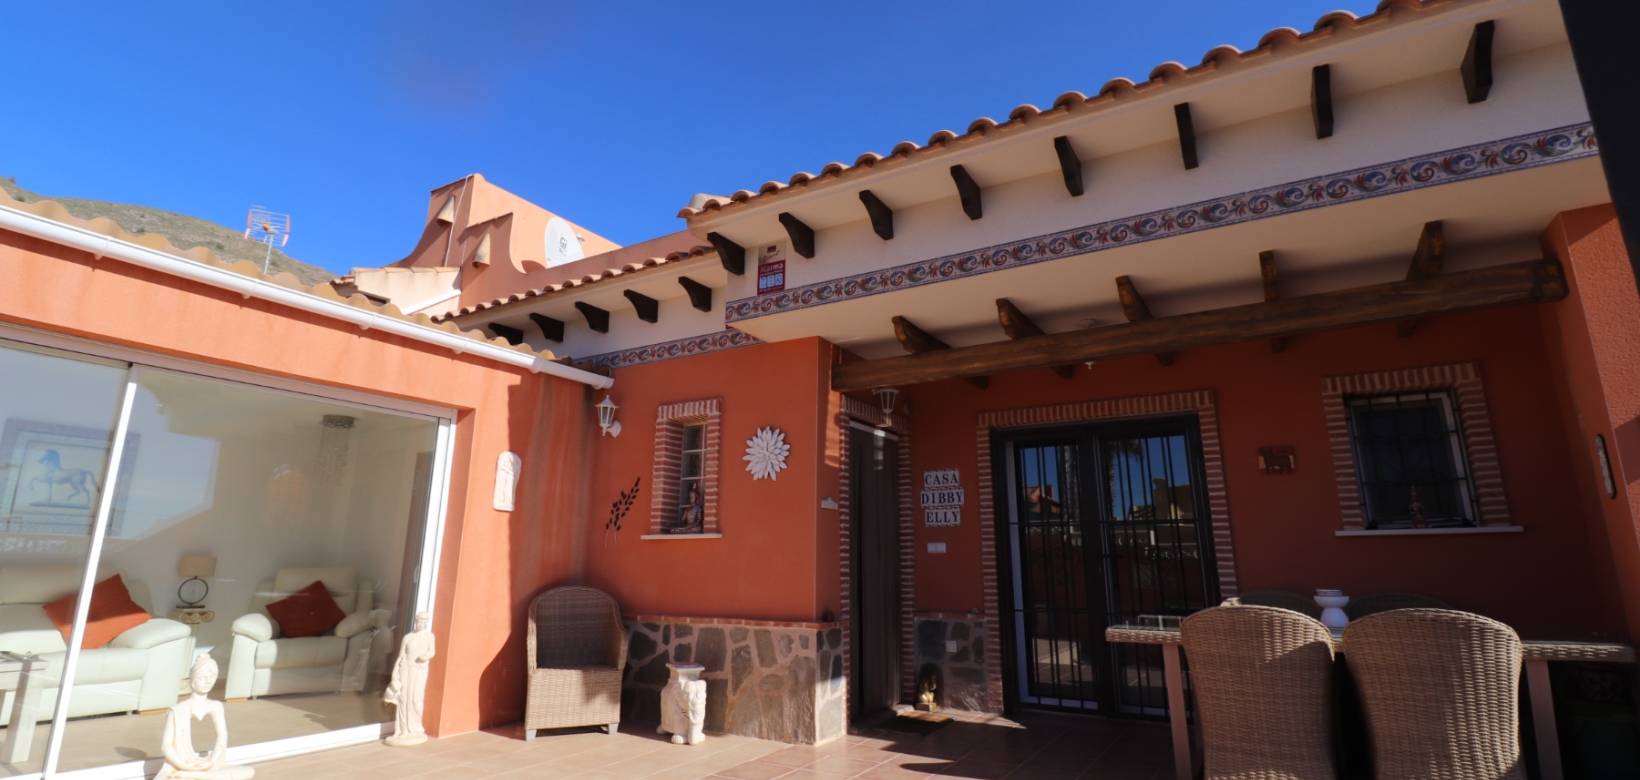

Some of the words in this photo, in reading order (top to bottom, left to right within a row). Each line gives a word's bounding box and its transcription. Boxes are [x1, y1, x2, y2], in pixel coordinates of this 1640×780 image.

[924, 472, 959, 485] CASA
[921, 491, 963, 505] DIBBY
[926, 511, 960, 523] ELLY
